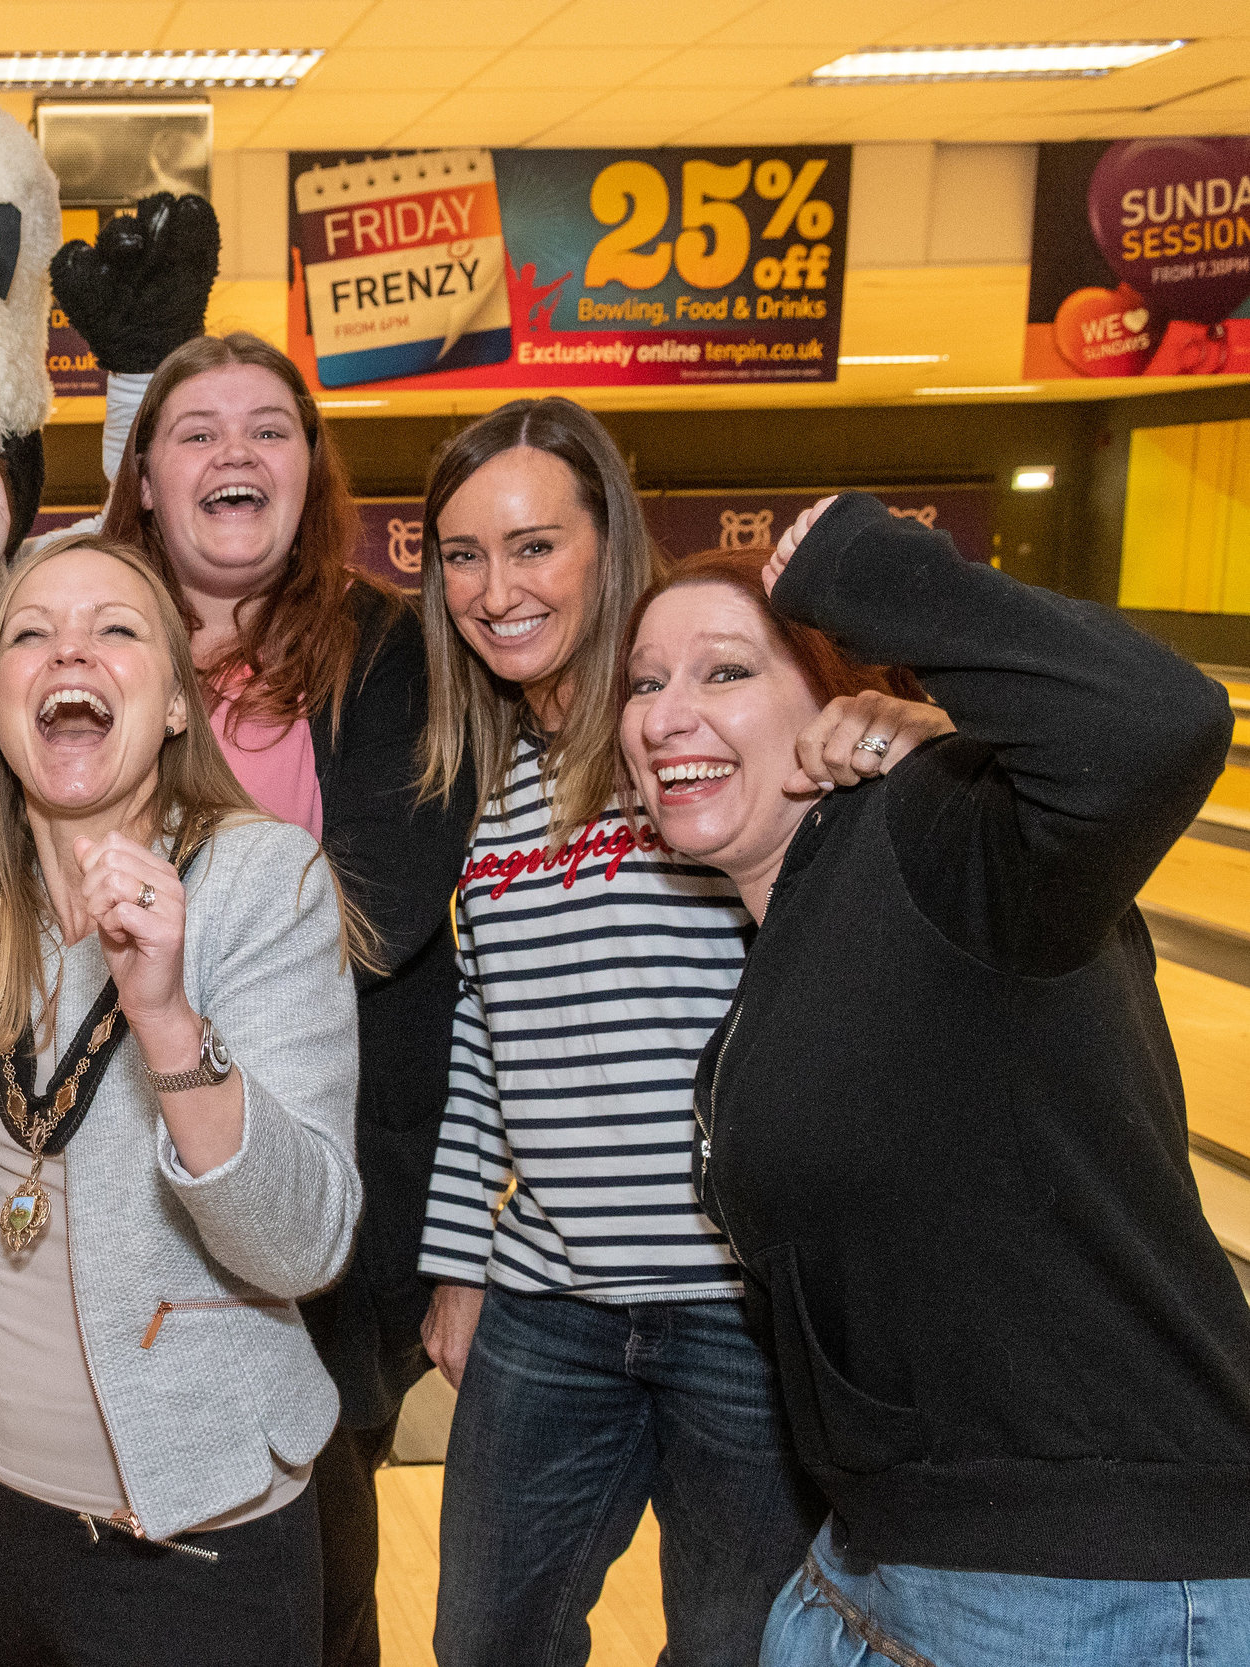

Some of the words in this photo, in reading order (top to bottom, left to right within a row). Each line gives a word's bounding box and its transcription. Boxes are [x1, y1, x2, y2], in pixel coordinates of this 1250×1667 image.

[324, 193, 476, 256] FRIDAY
[584, 159, 835, 289] 25%
[331, 259, 480, 313] FRENZY
[753, 244, 832, 290] off
[334, 320, 377, 339] FROM
[578, 298, 670, 326] Bowling,
[675, 297, 728, 320] Food
[732, 296, 751, 319] &
[755, 296, 827, 320] Drinks
[1081, 313, 1124, 344] WE
[518, 342, 634, 367] Exclusively
[637, 340, 701, 362] online
[705, 338, 824, 366] tenpin.co.uk
